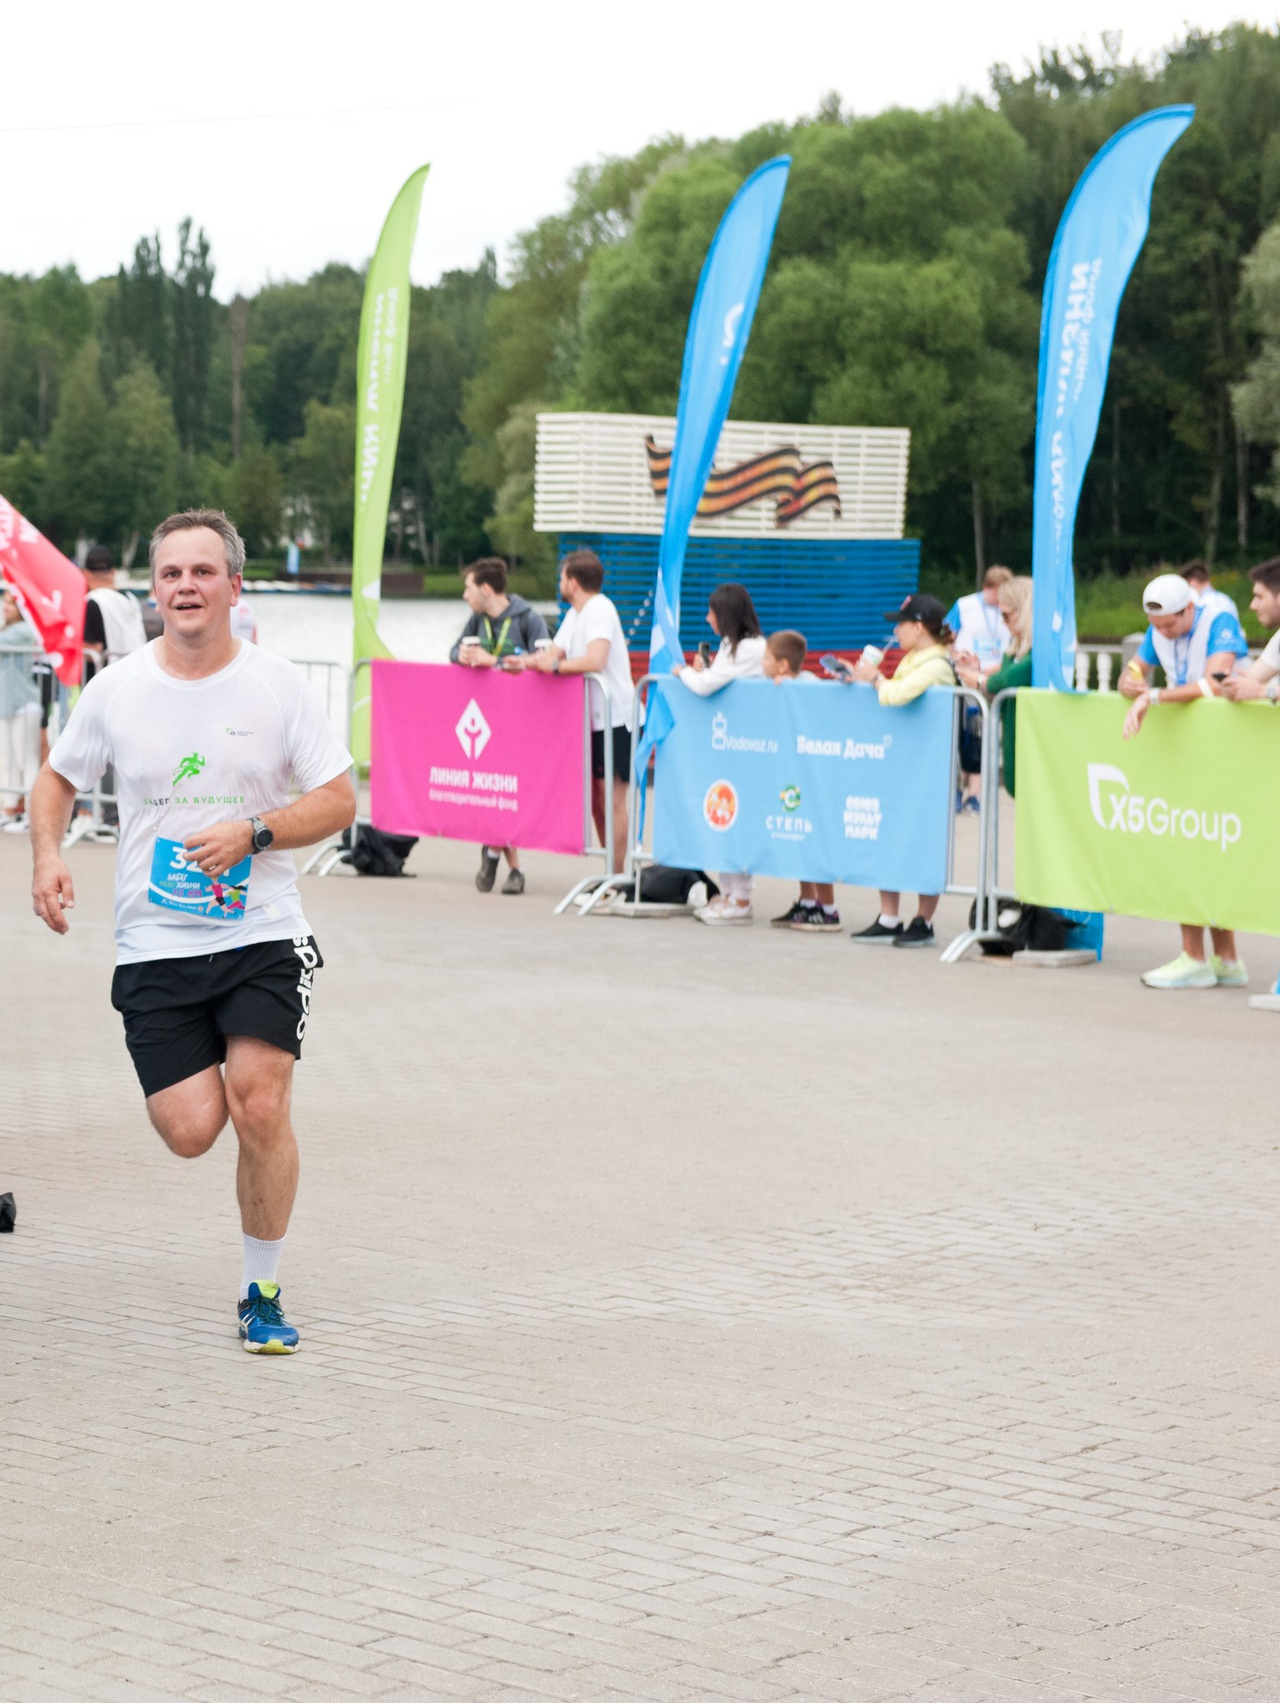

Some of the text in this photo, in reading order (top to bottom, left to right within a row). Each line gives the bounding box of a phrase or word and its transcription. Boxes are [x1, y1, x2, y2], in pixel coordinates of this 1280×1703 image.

[796, 735, 885, 759] Белая Дача
[429, 766, 518, 793] ЛИНИЯ ЖИЗНИ
[175, 796, 188, 804] ЗА
[194, 796, 245, 804] БУДУЩЕЕ
[765, 815, 813, 833] СТЕПЬ
[1108, 793, 1242, 852] X5Group
